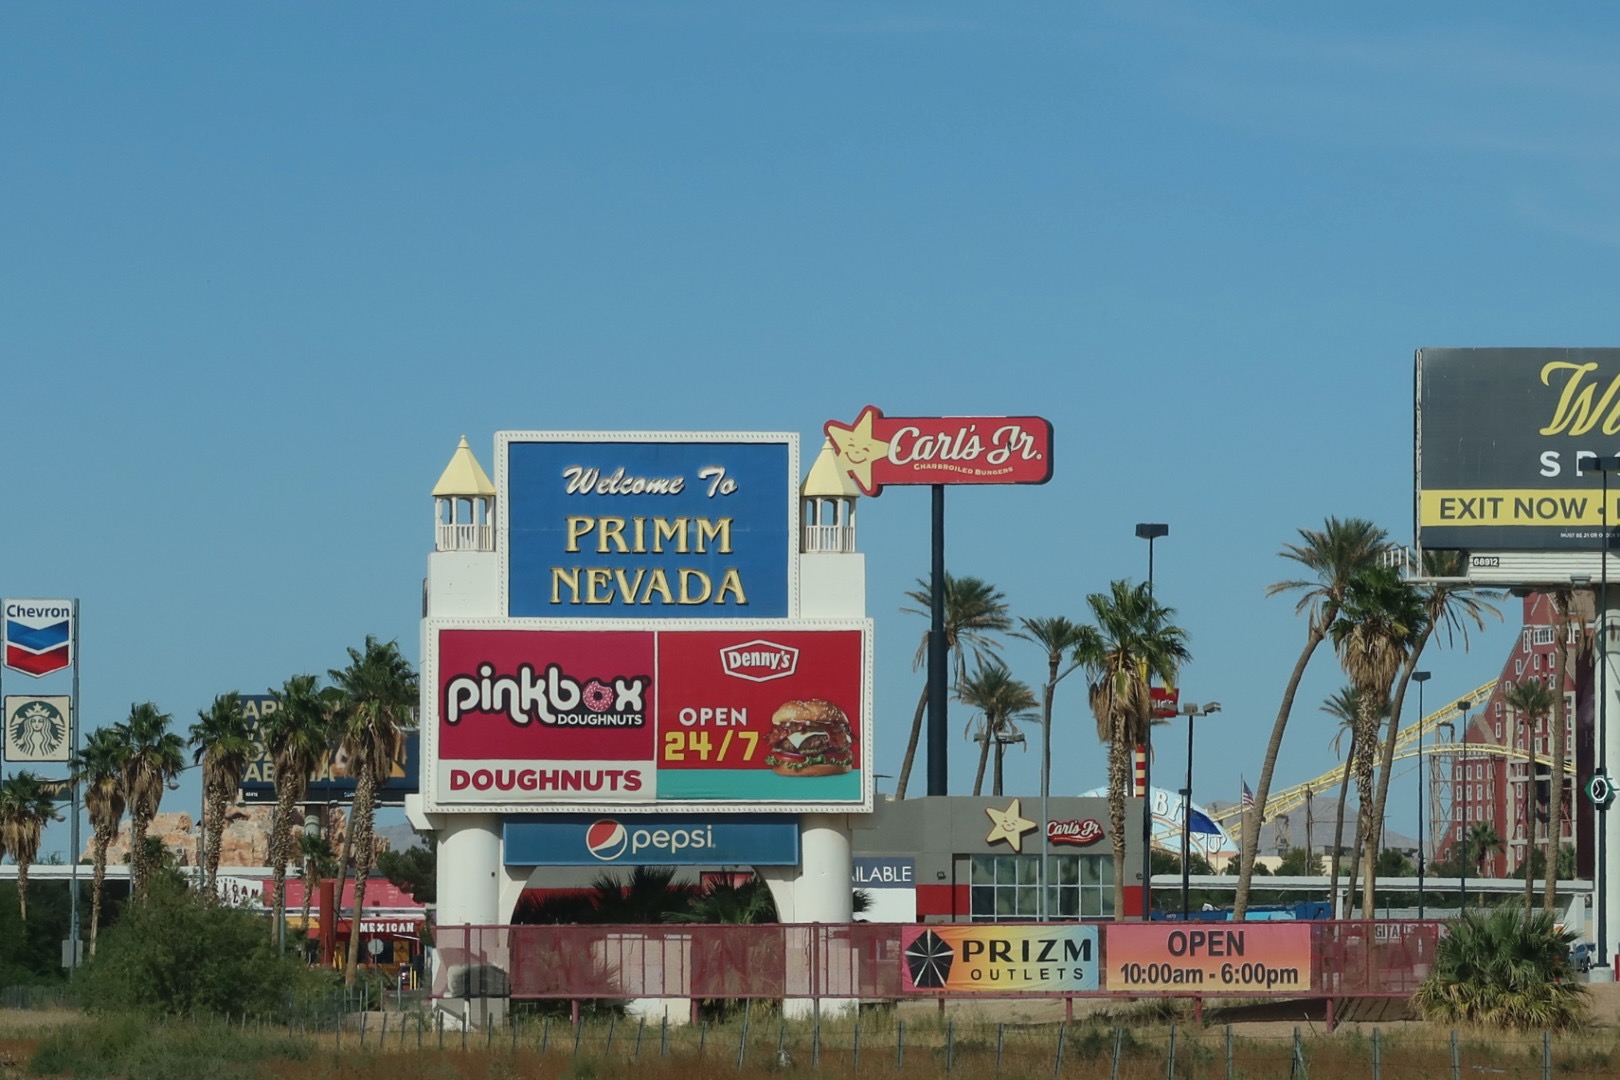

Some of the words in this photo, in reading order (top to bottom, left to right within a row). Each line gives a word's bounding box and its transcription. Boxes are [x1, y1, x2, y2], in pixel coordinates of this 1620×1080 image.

[888, 425, 985, 465] Carl's
[986, 425, 1043, 465] Jr.
[913, 463, 973, 475] CHARBROILED
[975, 466, 1014, 476] BURGERS
[563, 465, 684, 495] Welcome
[698, 466, 738, 497] To
[1440, 497, 1504, 519] EXIT
[1513, 497, 1588, 519] NOW
[565, 516, 733, 553] PRIMM
[550, 567, 748, 605] NEVADA
[6, 604, 70, 618] Chevron
[728, 650, 791, 670] Denny's
[448, 665, 643, 724] pinkbox
[557, 713, 643, 725] DOUGHNUTS
[679, 707, 748, 726] OPEN
[664, 729, 759, 762] 24/7
[449, 769, 642, 791] DOUGHNUTS
[632, 824, 712, 854] pepsi
[1047, 820, 1081, 836] Carl's
[852, 866, 912, 882] ILABLE
[360, 922, 415, 933] MEXICAN
[962, 939, 1091, 963] PRIZM
[1167, 930, 1245, 957] OPEN
[970, 968, 1084, 981] OUTLETS
[1120, 963, 1203, 984] 10:00am
[1221, 963, 1298, 989] 6:00pm
